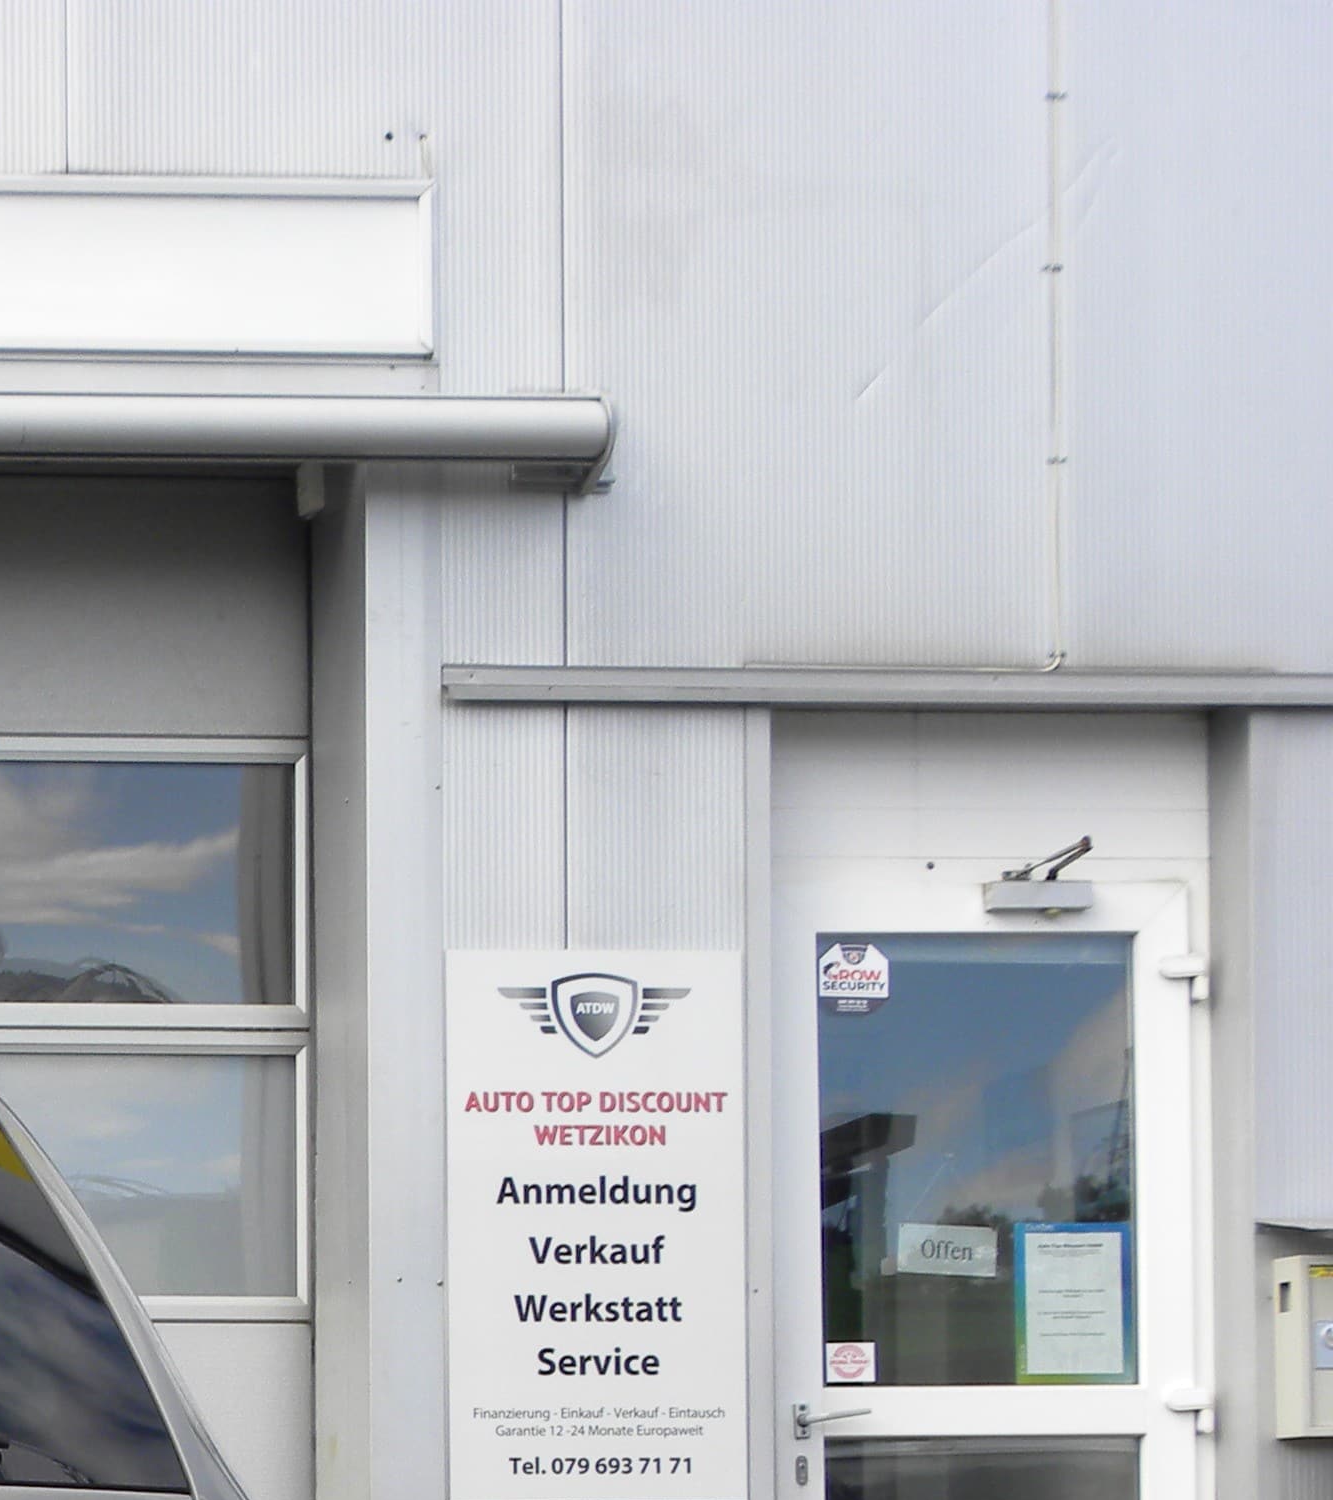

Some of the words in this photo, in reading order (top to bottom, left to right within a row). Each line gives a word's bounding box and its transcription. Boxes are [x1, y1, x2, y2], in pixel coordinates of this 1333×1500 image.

[822, 980, 886, 991] SECURITY
[575, 1001, 615, 1015] ATDW
[464, 1091, 534, 1113] AUTO
[541, 1091, 592, 1113] TOP
[599, 1091, 728, 1113] DISCOUNT
[533, 1124, 666, 1146] WETZIKON
[496, 1175, 697, 1213] Anmeldung
[528, 1235, 666, 1265] Verkauf
[921, 1239, 973, 1260] Offen
[513, 1293, 683, 1323] Werkstatt
[537, 1347, 660, 1376] Service
[473, 1407, 551, 1421] Finanzierung
[560, 1407, 605, 1419] Einkauf
[613, 1407, 660, 1419] Verkauf
[669, 1407, 726, 1419] Eintausch
[495, 1425, 546, 1437] Garantie
[550, 1425, 564, 1436] 12
[588, 1425, 634, 1437] Monate
[636, 1425, 704, 1438] Europaweit
[509, 1457, 547, 1475] Tel.
[551, 1457, 590, 1475] 079
[594, 1457, 633, 1475] 693
[639, 1457, 662, 1475] 71
[669, 1457, 693, 1475] 71
